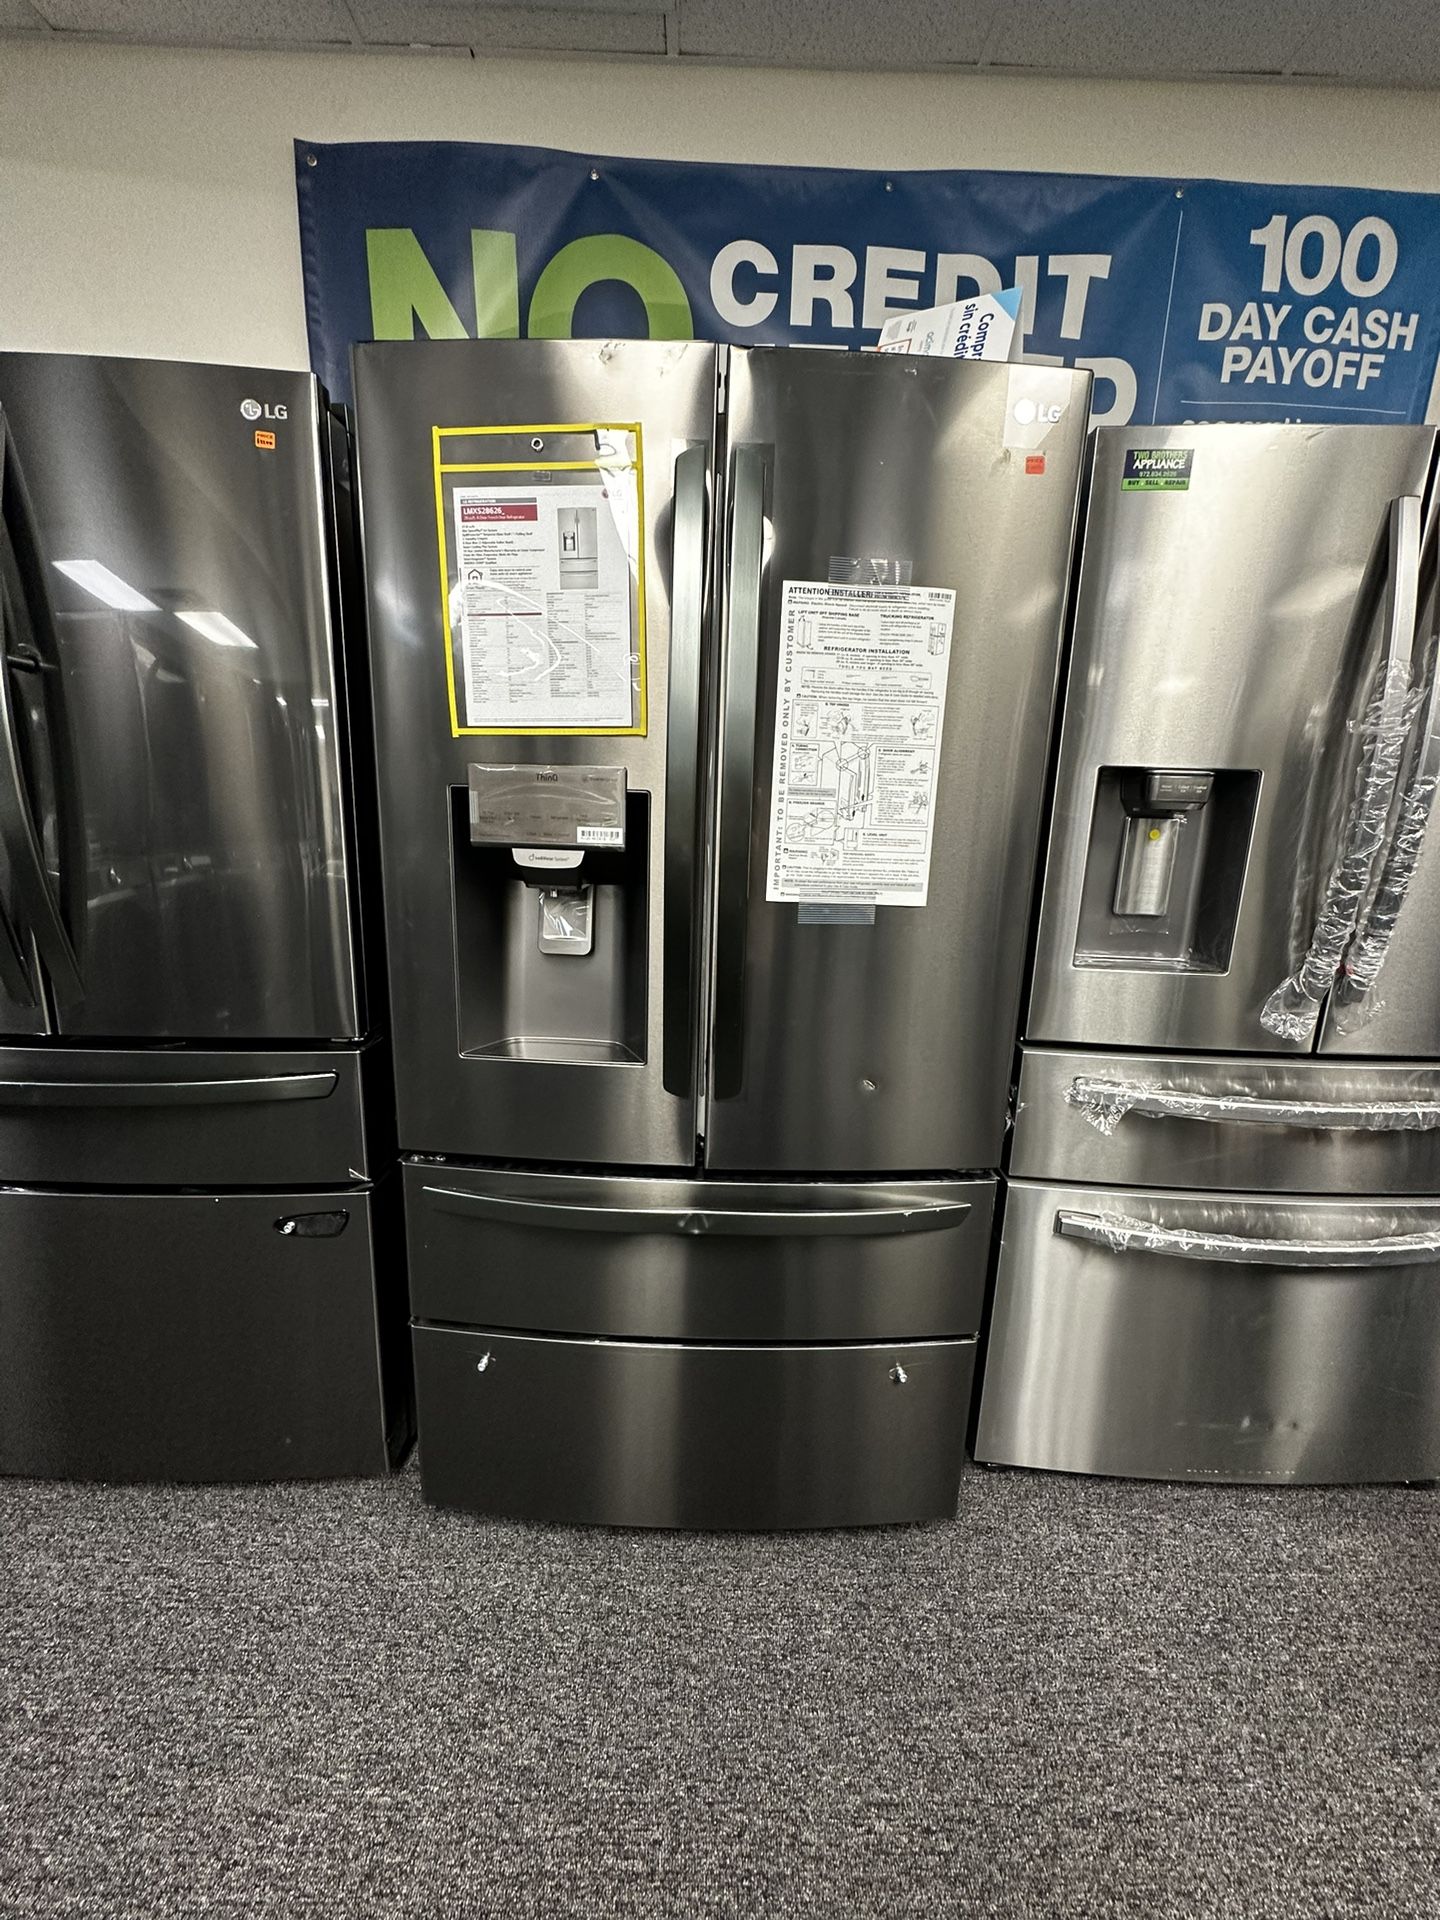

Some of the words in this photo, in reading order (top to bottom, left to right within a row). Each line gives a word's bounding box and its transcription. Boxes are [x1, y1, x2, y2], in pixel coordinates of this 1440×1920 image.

[1249, 214, 1399, 298] 100
[365, 228, 694, 340] NO
[710, 239, 1113, 341] CREDIT
[962, 303, 979, 323] sin
[971, 312, 996, 361] Compr
[1198, 303, 1292, 343] DAY
[1303, 305, 1420, 352] CASH
[1220, 345, 1386, 391] PAYOFF
[264, 404, 288, 419] LG
[1038, 404, 1062, 423] LG
[1133, 451, 1149, 460] TWO
[1151, 451, 1188, 461] BROTHERS
[1133, 459, 1186, 470] APPLIANCE
[788, 586, 830, 596] ATTENTION
[785, 609, 796, 673] CUSTOMER
[824, 646, 867, 654] REFRIGERATOR
[784, 678, 791, 692] BY
[782, 699, 790, 727] ONLY
[779, 732, 788, 784] REMOVED
[536, 773, 558, 782] ThinQ
[778, 789, 785, 803] BE
[776, 808, 784, 821] TO
[773, 826, 784, 890] IMPORTANT:
